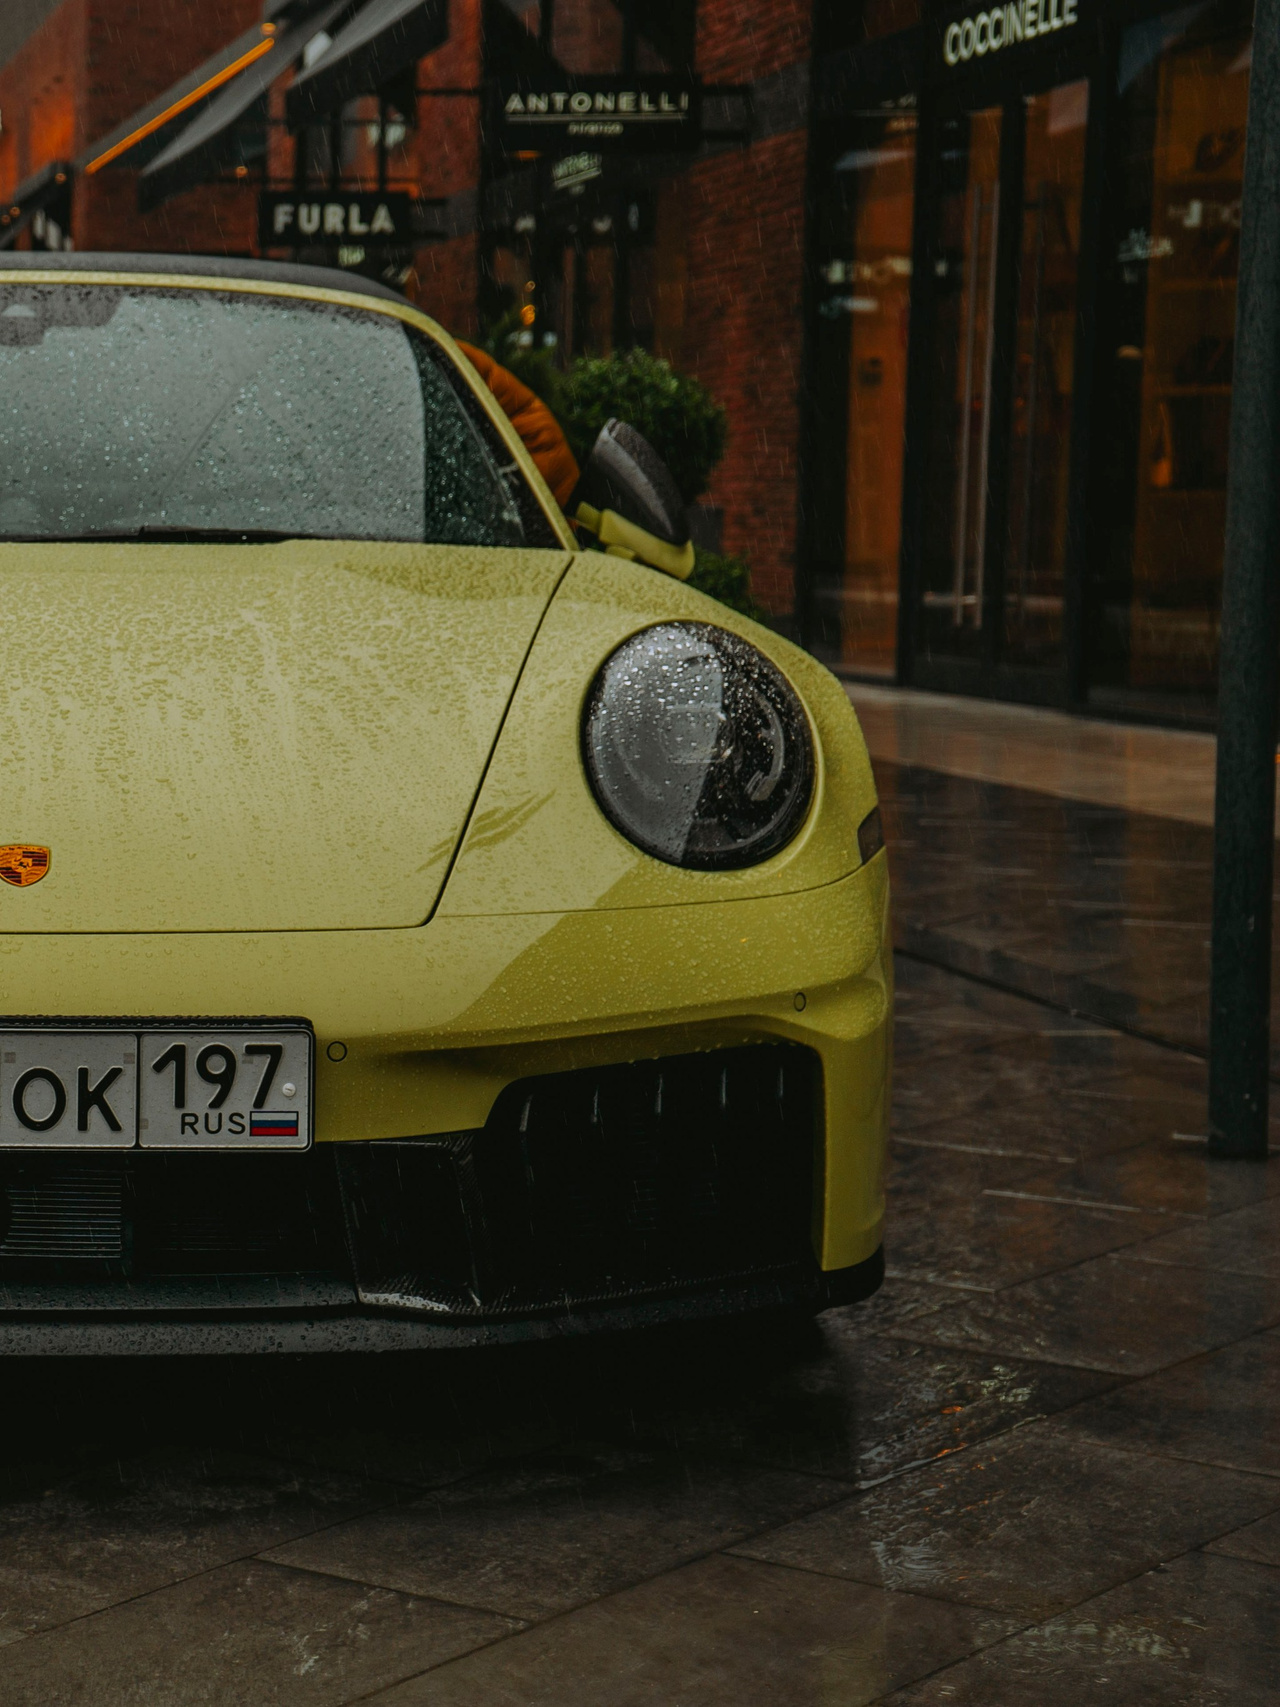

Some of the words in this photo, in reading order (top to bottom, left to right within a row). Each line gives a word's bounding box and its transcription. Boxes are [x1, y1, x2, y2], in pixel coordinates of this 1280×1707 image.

[943, 0, 1079, 66] COCCINELLE
[504, 91, 690, 115] ANTONELLI
[272, 203, 396, 236] FURLA
[151, 1042, 284, 1110] 197
[181, 1111, 248, 1137] RUS
